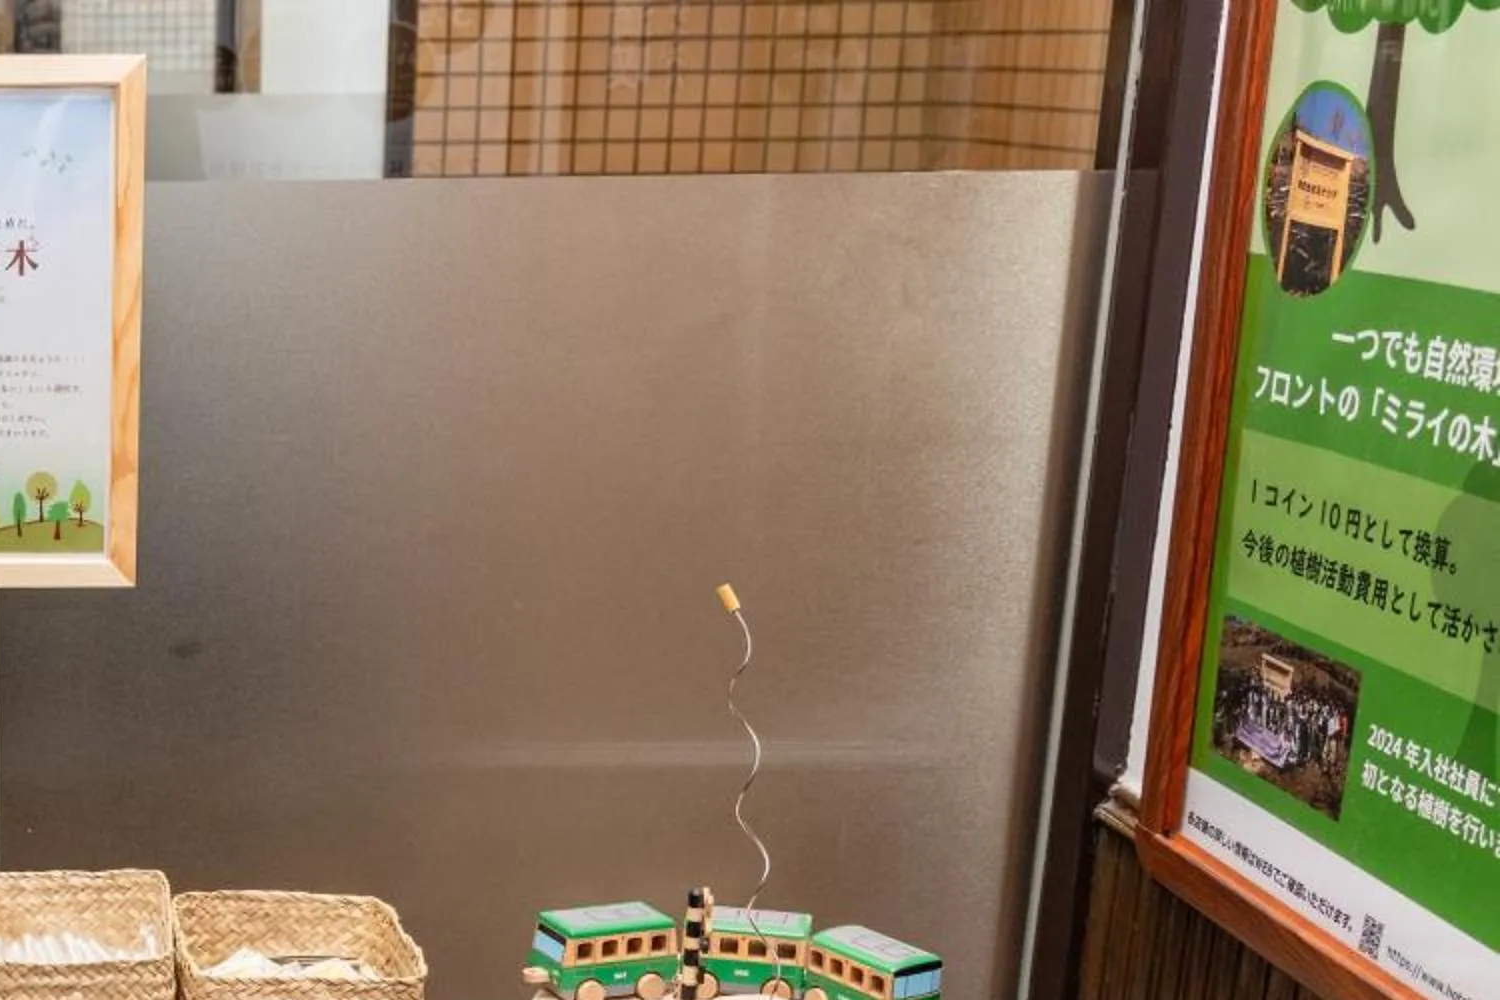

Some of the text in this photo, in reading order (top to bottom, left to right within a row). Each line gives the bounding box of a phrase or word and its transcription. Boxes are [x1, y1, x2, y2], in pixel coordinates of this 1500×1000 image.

[1255, 365, 1500, 467] フロントの「ミライの木」
[1241, 528, 1500, 653] 今後の植樹活動費用として活かさ
[1367, 723, 1500, 807] 2024年入社社員に
